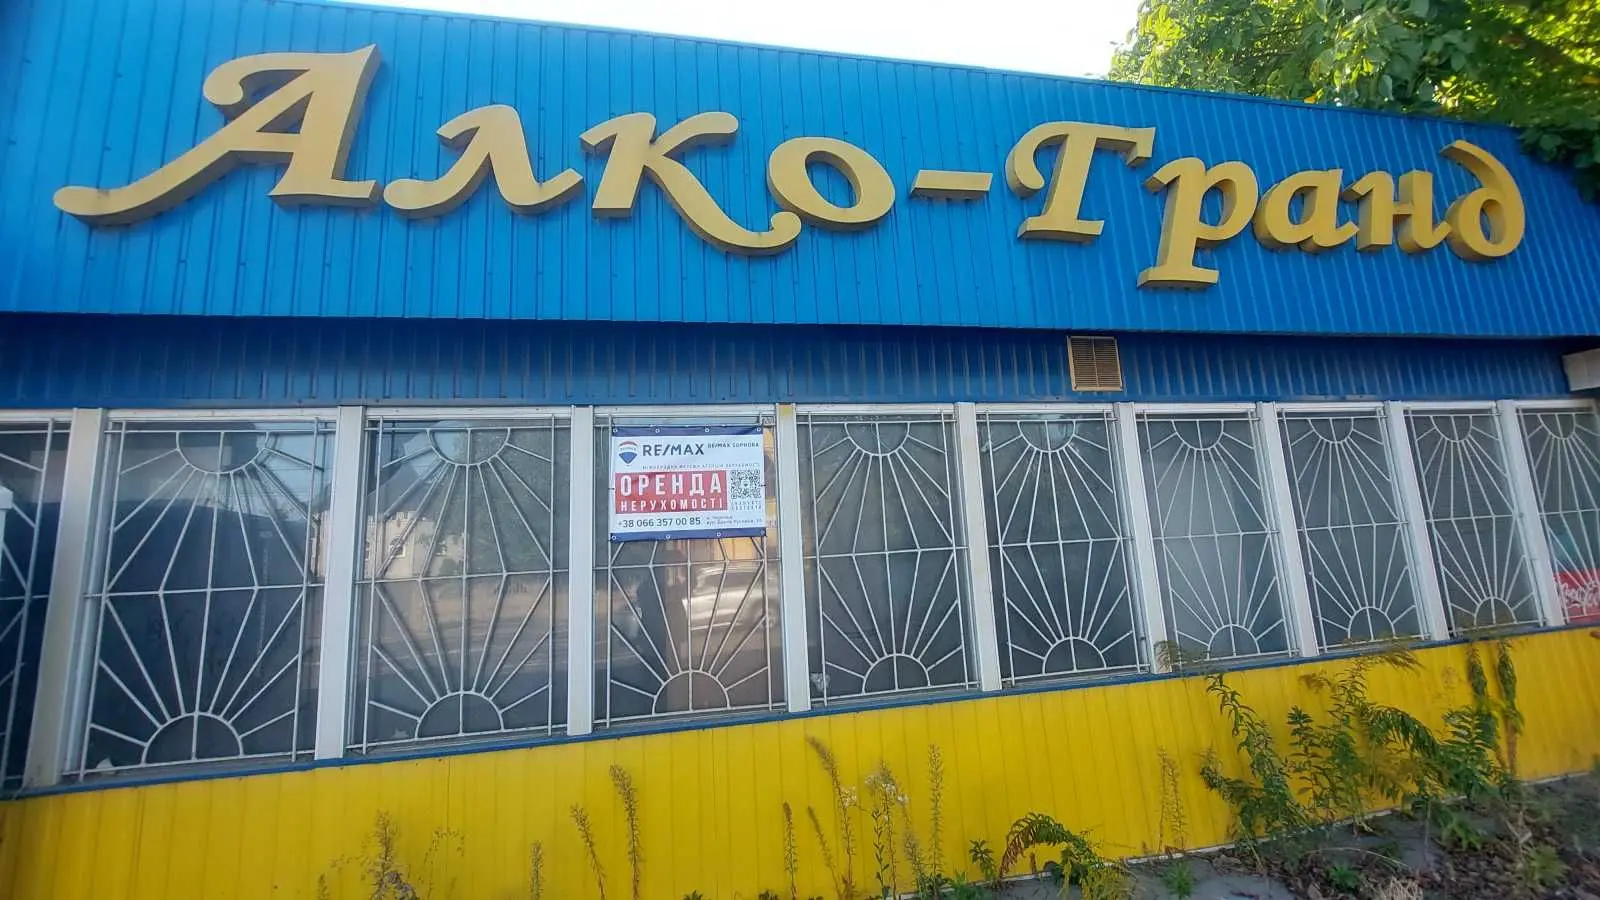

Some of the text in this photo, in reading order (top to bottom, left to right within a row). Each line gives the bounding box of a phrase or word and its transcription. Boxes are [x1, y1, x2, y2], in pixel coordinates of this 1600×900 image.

[53, 43, 1526, 289] Алко-Гранд
[642, 443, 705, 457] RE/MAX
[620, 473, 722, 496] ОРЕНДА
[620, 498, 722, 511] НЕРУХОМОСТІ
[618, 519, 634, 528] +38
[636, 518, 655, 527] 066
[656, 518, 673, 526] 357
[675, 517, 687, 526] 00
[689, 517, 701, 525] 85
